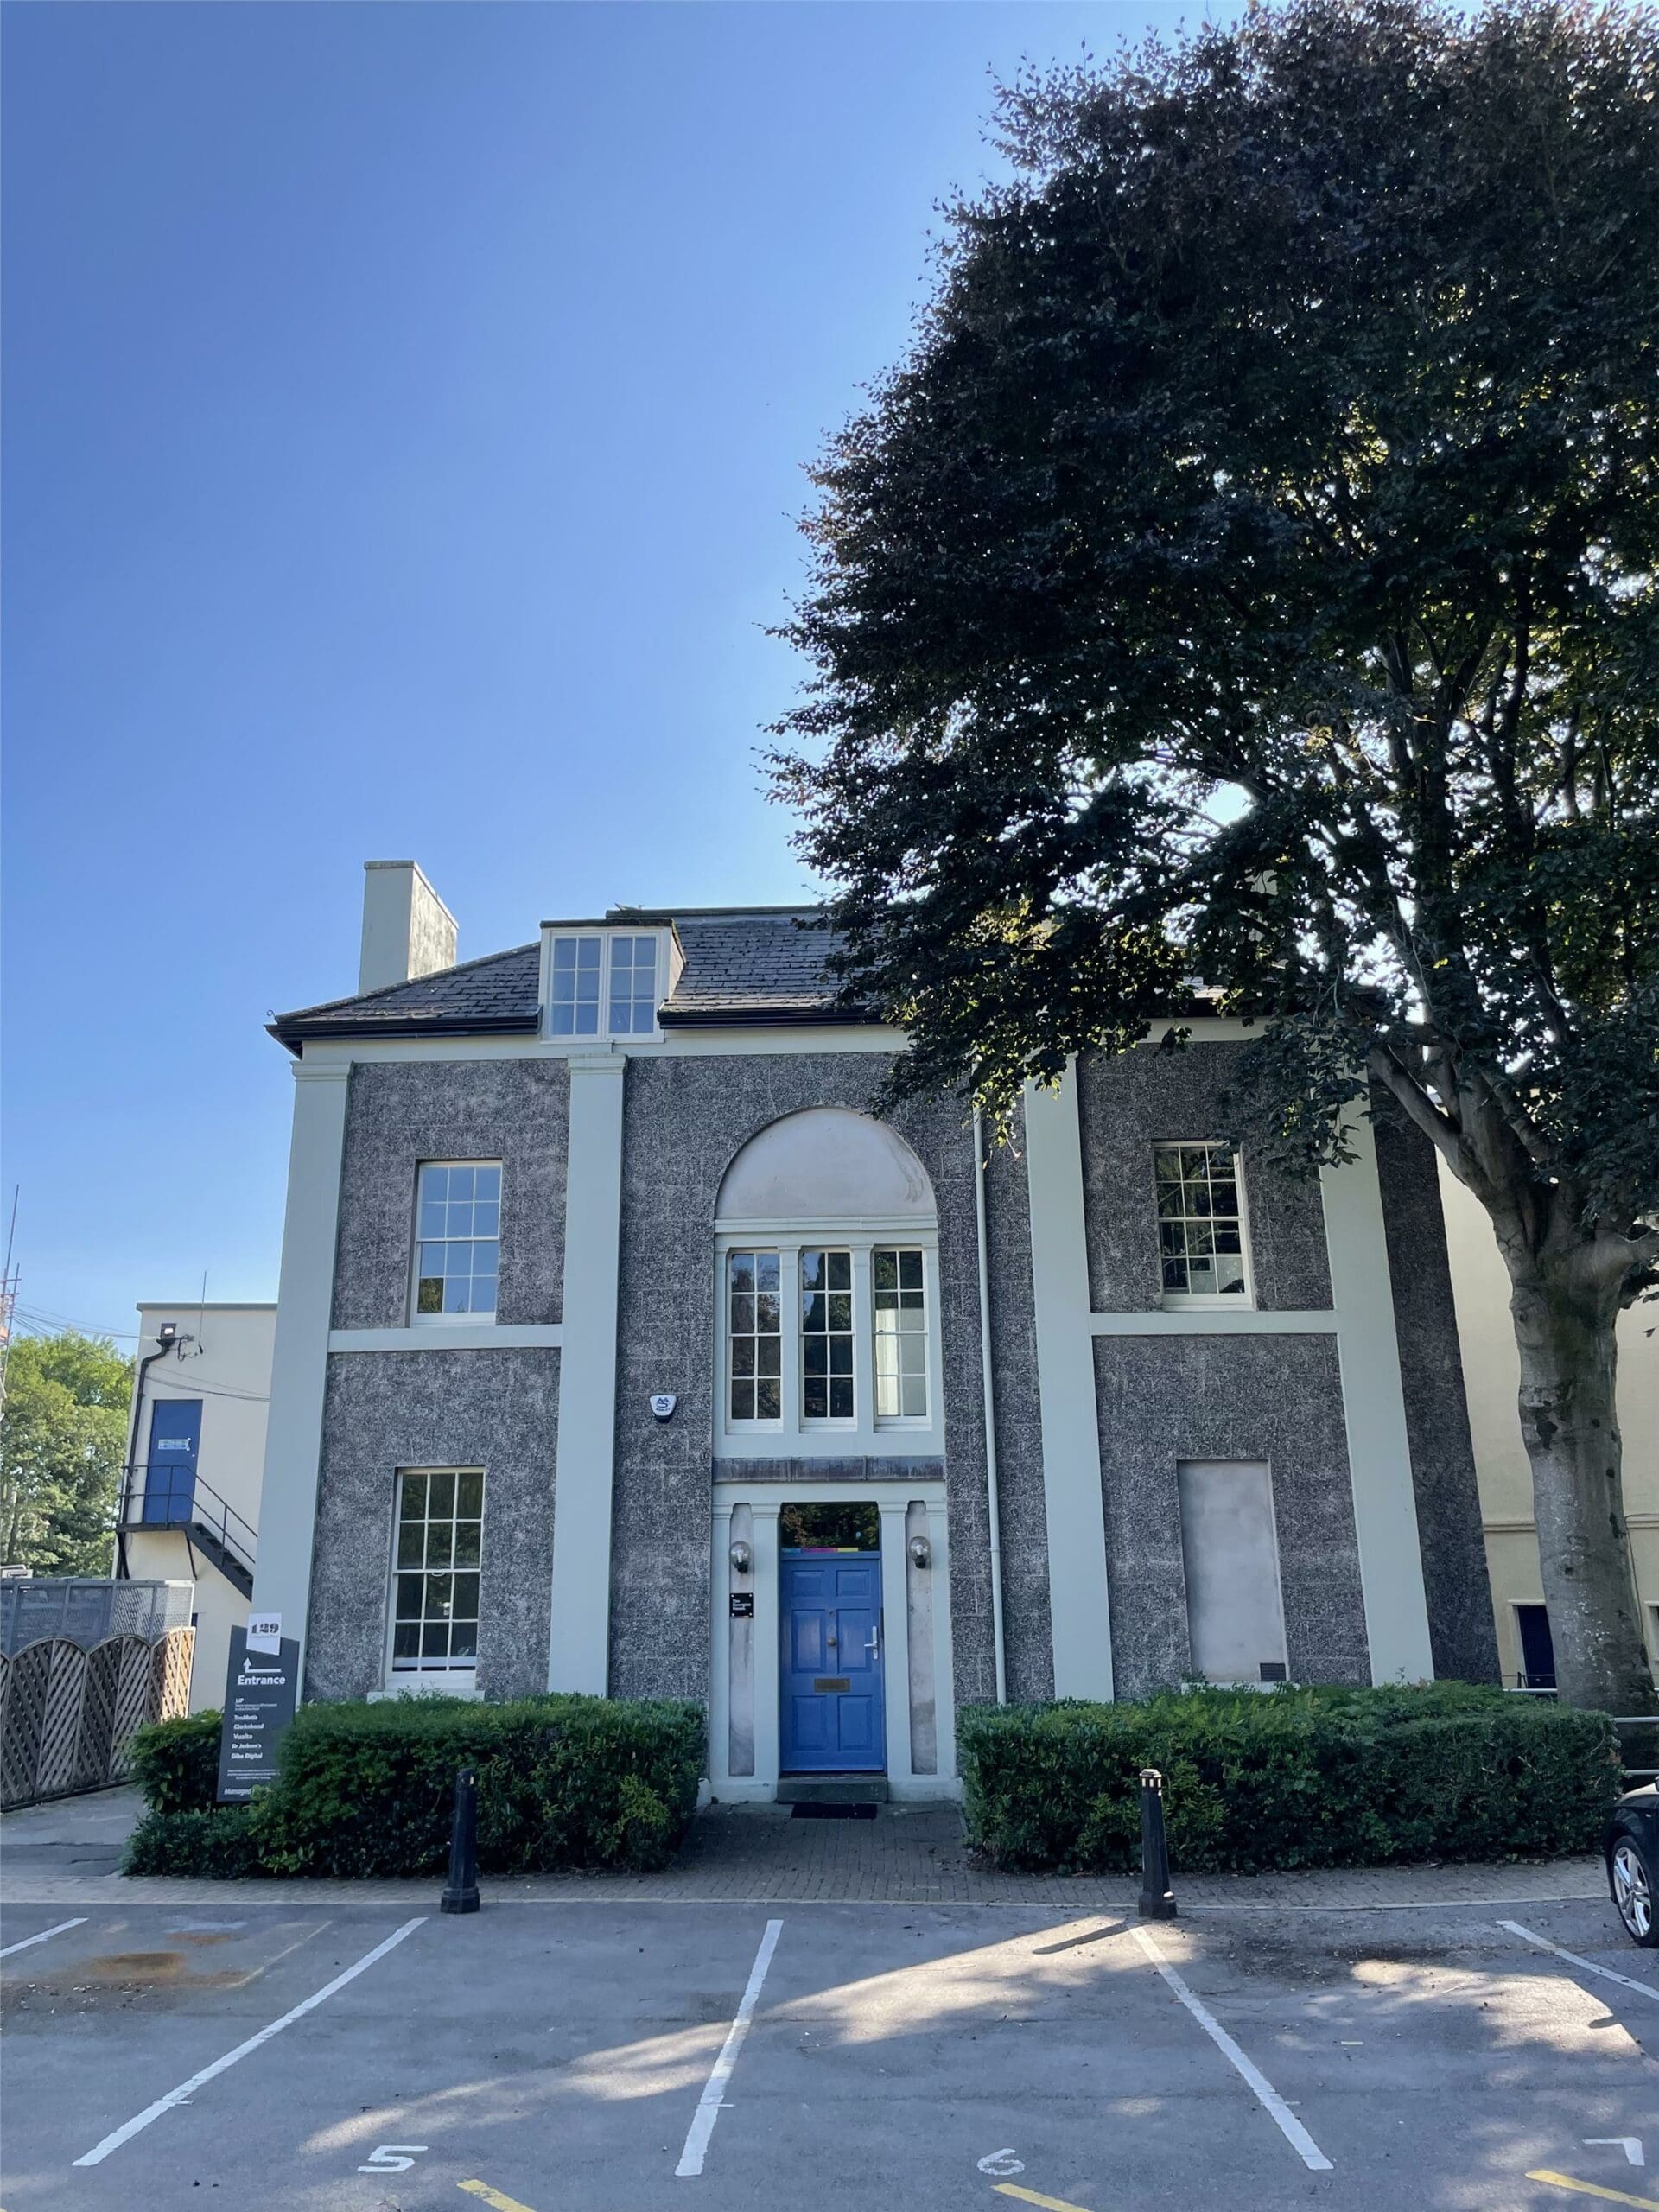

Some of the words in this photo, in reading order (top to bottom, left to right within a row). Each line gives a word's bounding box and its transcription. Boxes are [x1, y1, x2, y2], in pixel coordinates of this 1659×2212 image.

[251, 1623, 279, 1634] 129
[237, 1675, 286, 1686] Entrance
[245, 1751, 264, 1760] Digital
[357, 2145, 429, 2173] 5
[1581, 2136, 1646, 2167] 7
[976, 2148, 1026, 2176] 6
